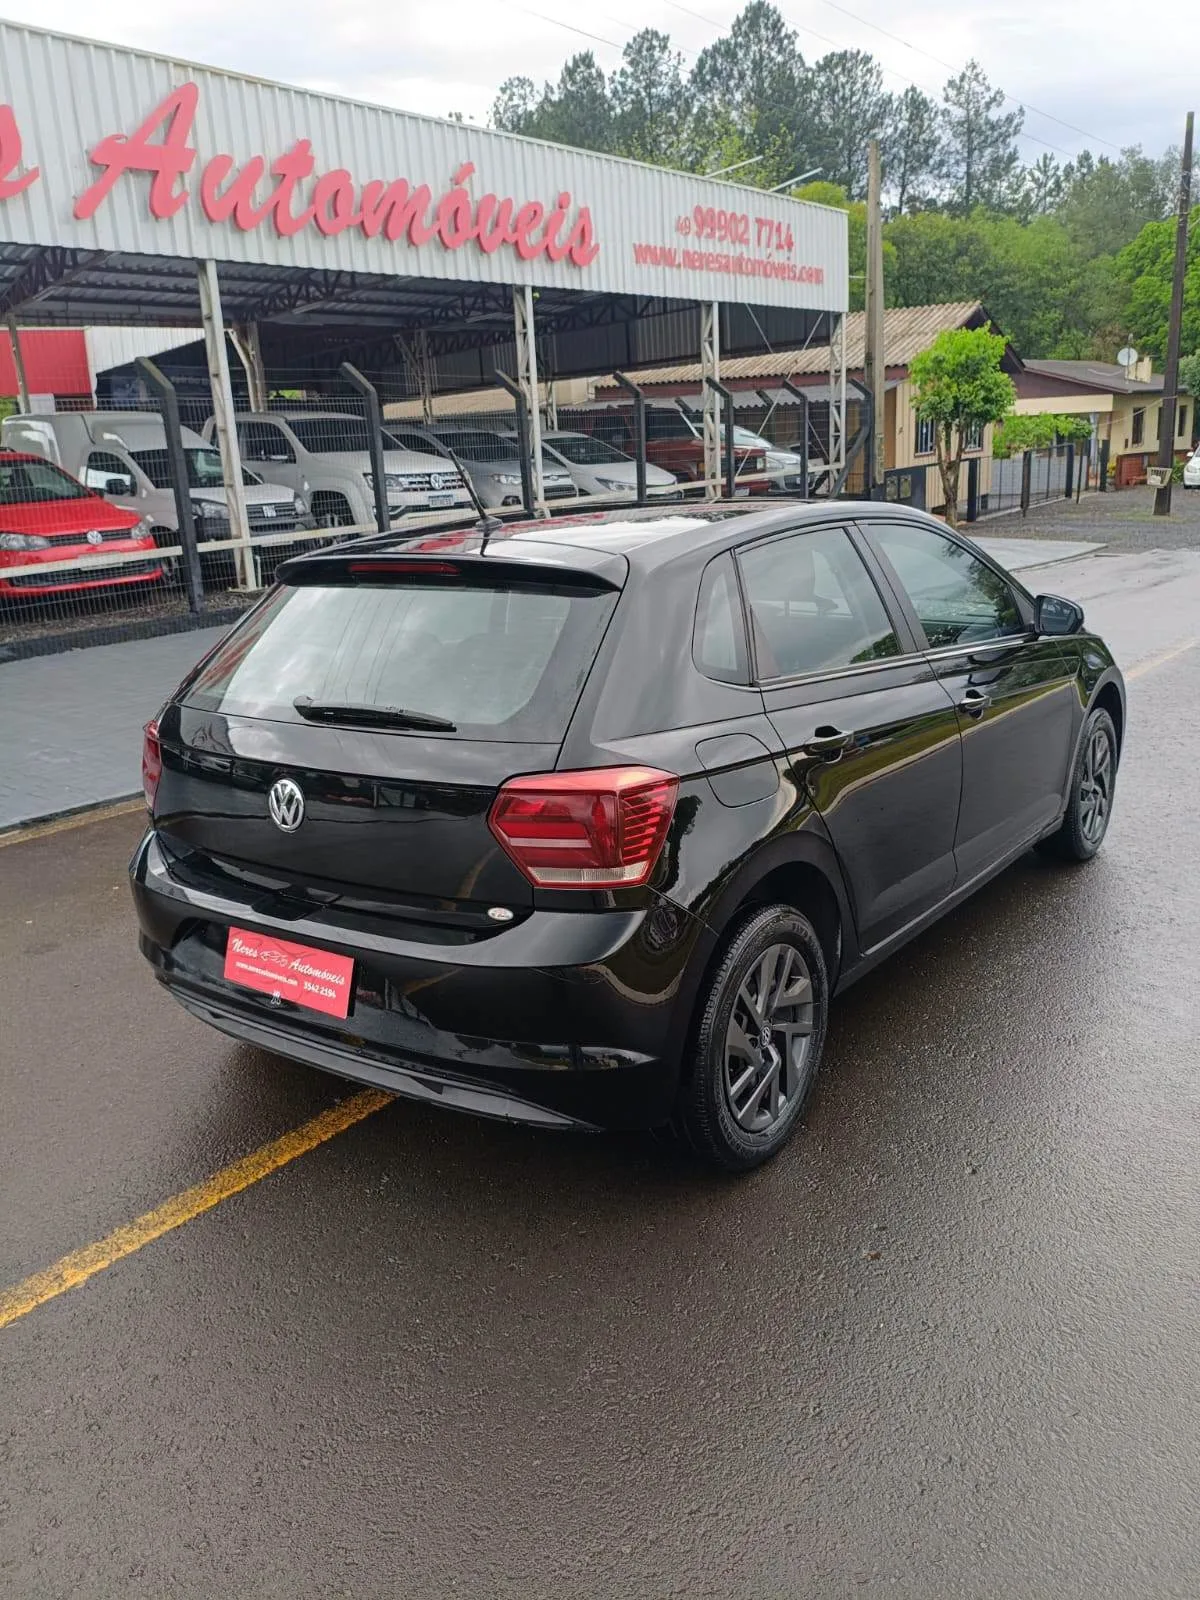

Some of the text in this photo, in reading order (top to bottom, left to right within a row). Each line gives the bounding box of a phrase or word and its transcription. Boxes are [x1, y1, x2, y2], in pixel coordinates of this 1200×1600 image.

[73, 81, 599, 267] Automóveis
[693, 205, 749, 246] 99902
[754, 217, 794, 250] 7714
[232, 938, 345, 985] Neres Automóveis
